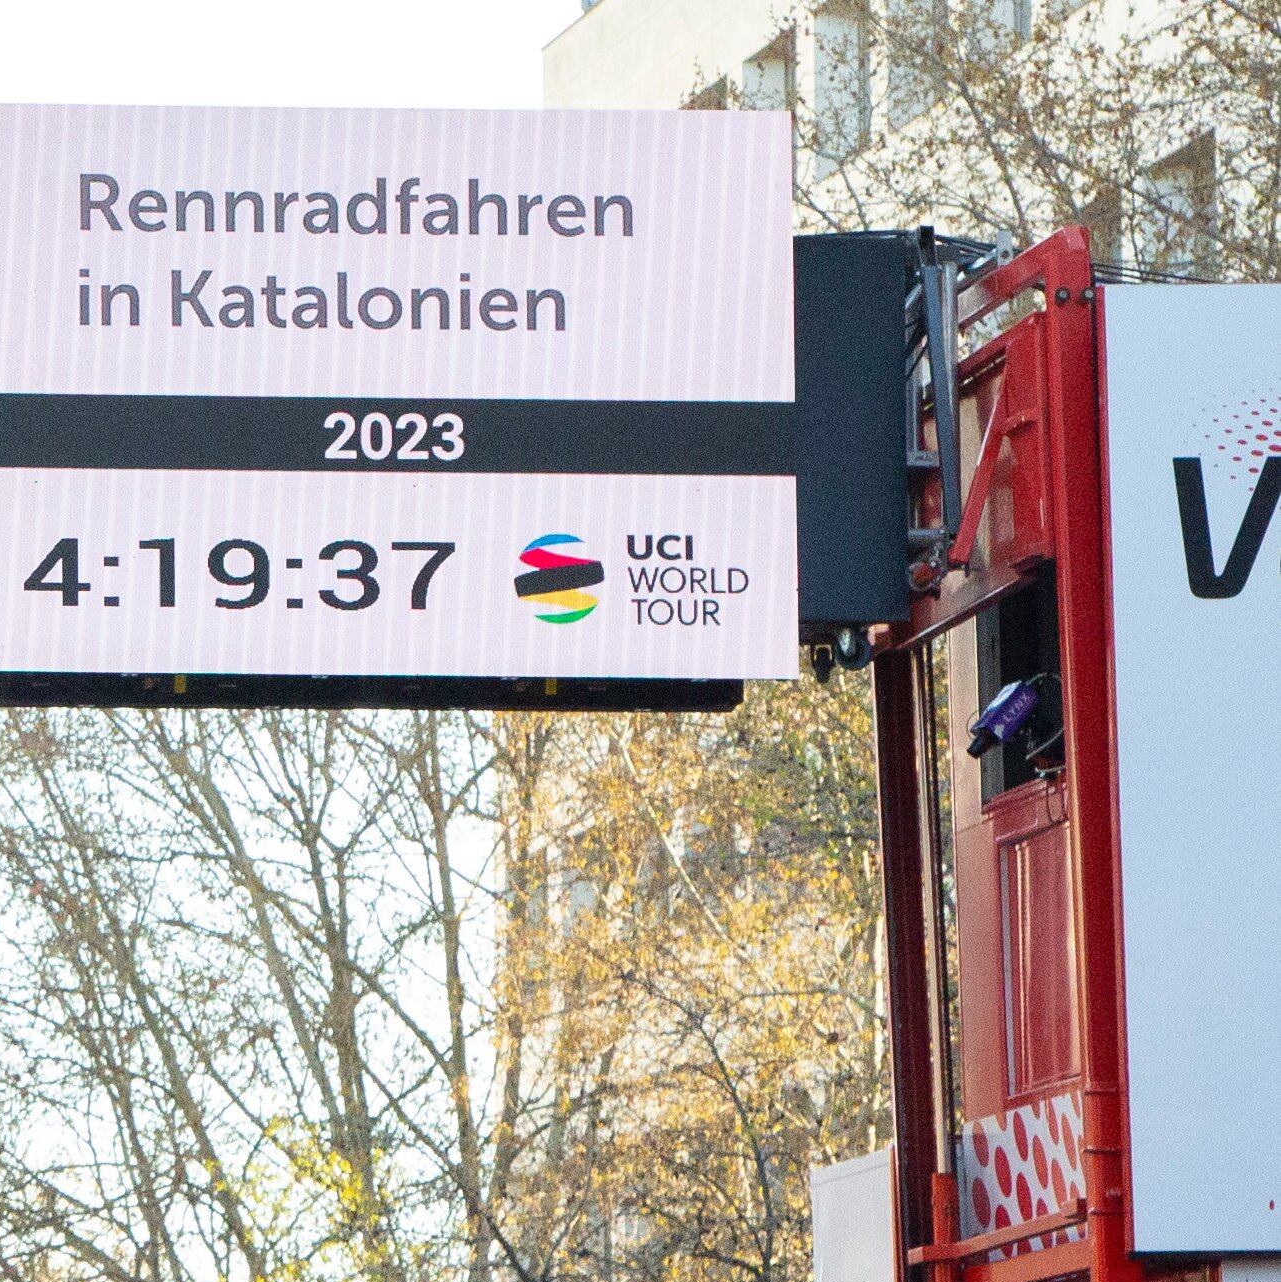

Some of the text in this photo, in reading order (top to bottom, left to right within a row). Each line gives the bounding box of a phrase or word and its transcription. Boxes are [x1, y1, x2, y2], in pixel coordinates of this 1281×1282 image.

[78, 172, 635, 238] Rennradfahren
[77, 268, 569, 333] in Katalonien
[323, 411, 466, 462] 2023
[626, 533, 694, 562] UCI
[1173, 457, 1281, 599] V
[23, 535, 456, 613] 4:19:37
[627, 565, 749, 597] WORLD
[630, 598, 721, 627] TOUR
